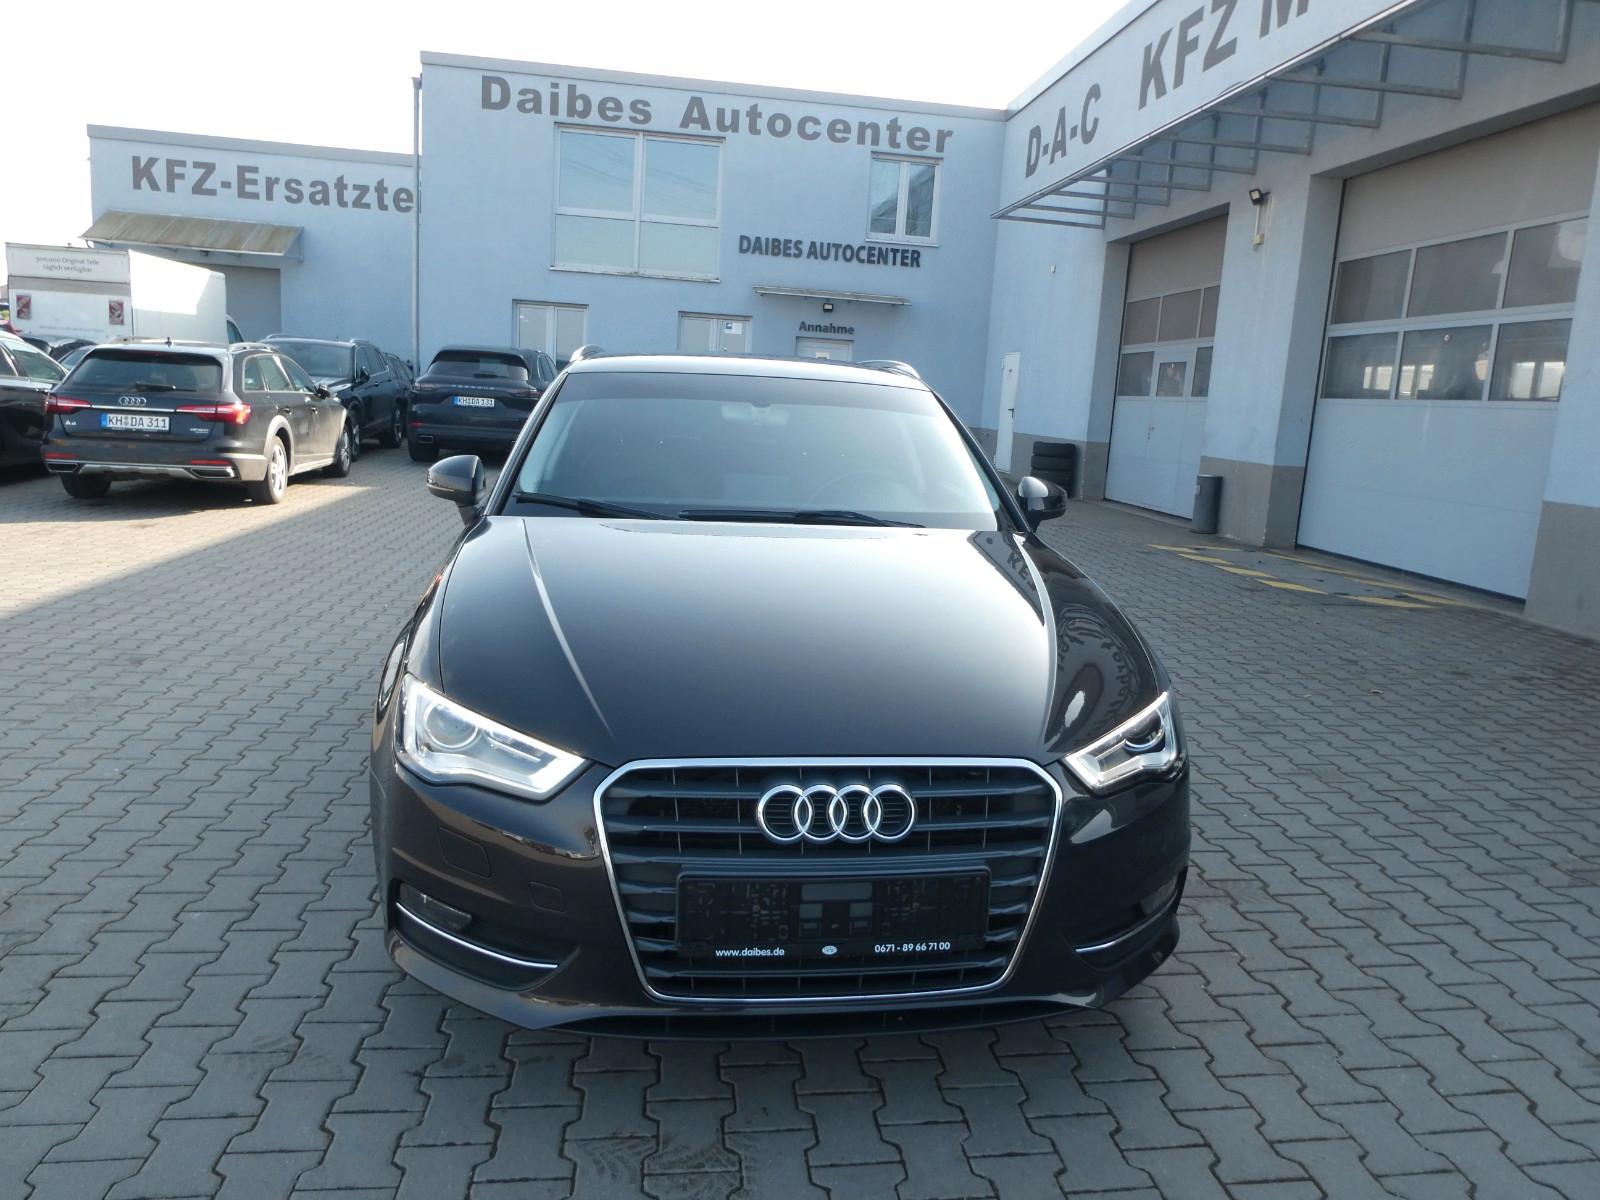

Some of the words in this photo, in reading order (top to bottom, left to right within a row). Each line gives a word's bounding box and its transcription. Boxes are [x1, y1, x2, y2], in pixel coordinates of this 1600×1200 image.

[1024, 83, 1101, 179] D-A-C
[1138, 0, 1239, 111] KFZ
[481, 75, 652, 125] Daibes
[679, 96, 953, 154] Autocenter
[131, 155, 421, 214] KFZ-Ersatzte
[738, 235, 803, 259] DAIBES
[806, 241, 921, 268] AUTOCENTER
[798, 321, 855, 335] Annahme
[107, 415, 123, 427] KH
[130, 416, 144, 428] DA
[146, 417, 167, 429] 311
[715, 947, 785, 957] www.daibes.de
[874, 944, 895, 953] 0671
[902, 943, 914, 952] 89
[915, 942, 927, 951] 66
